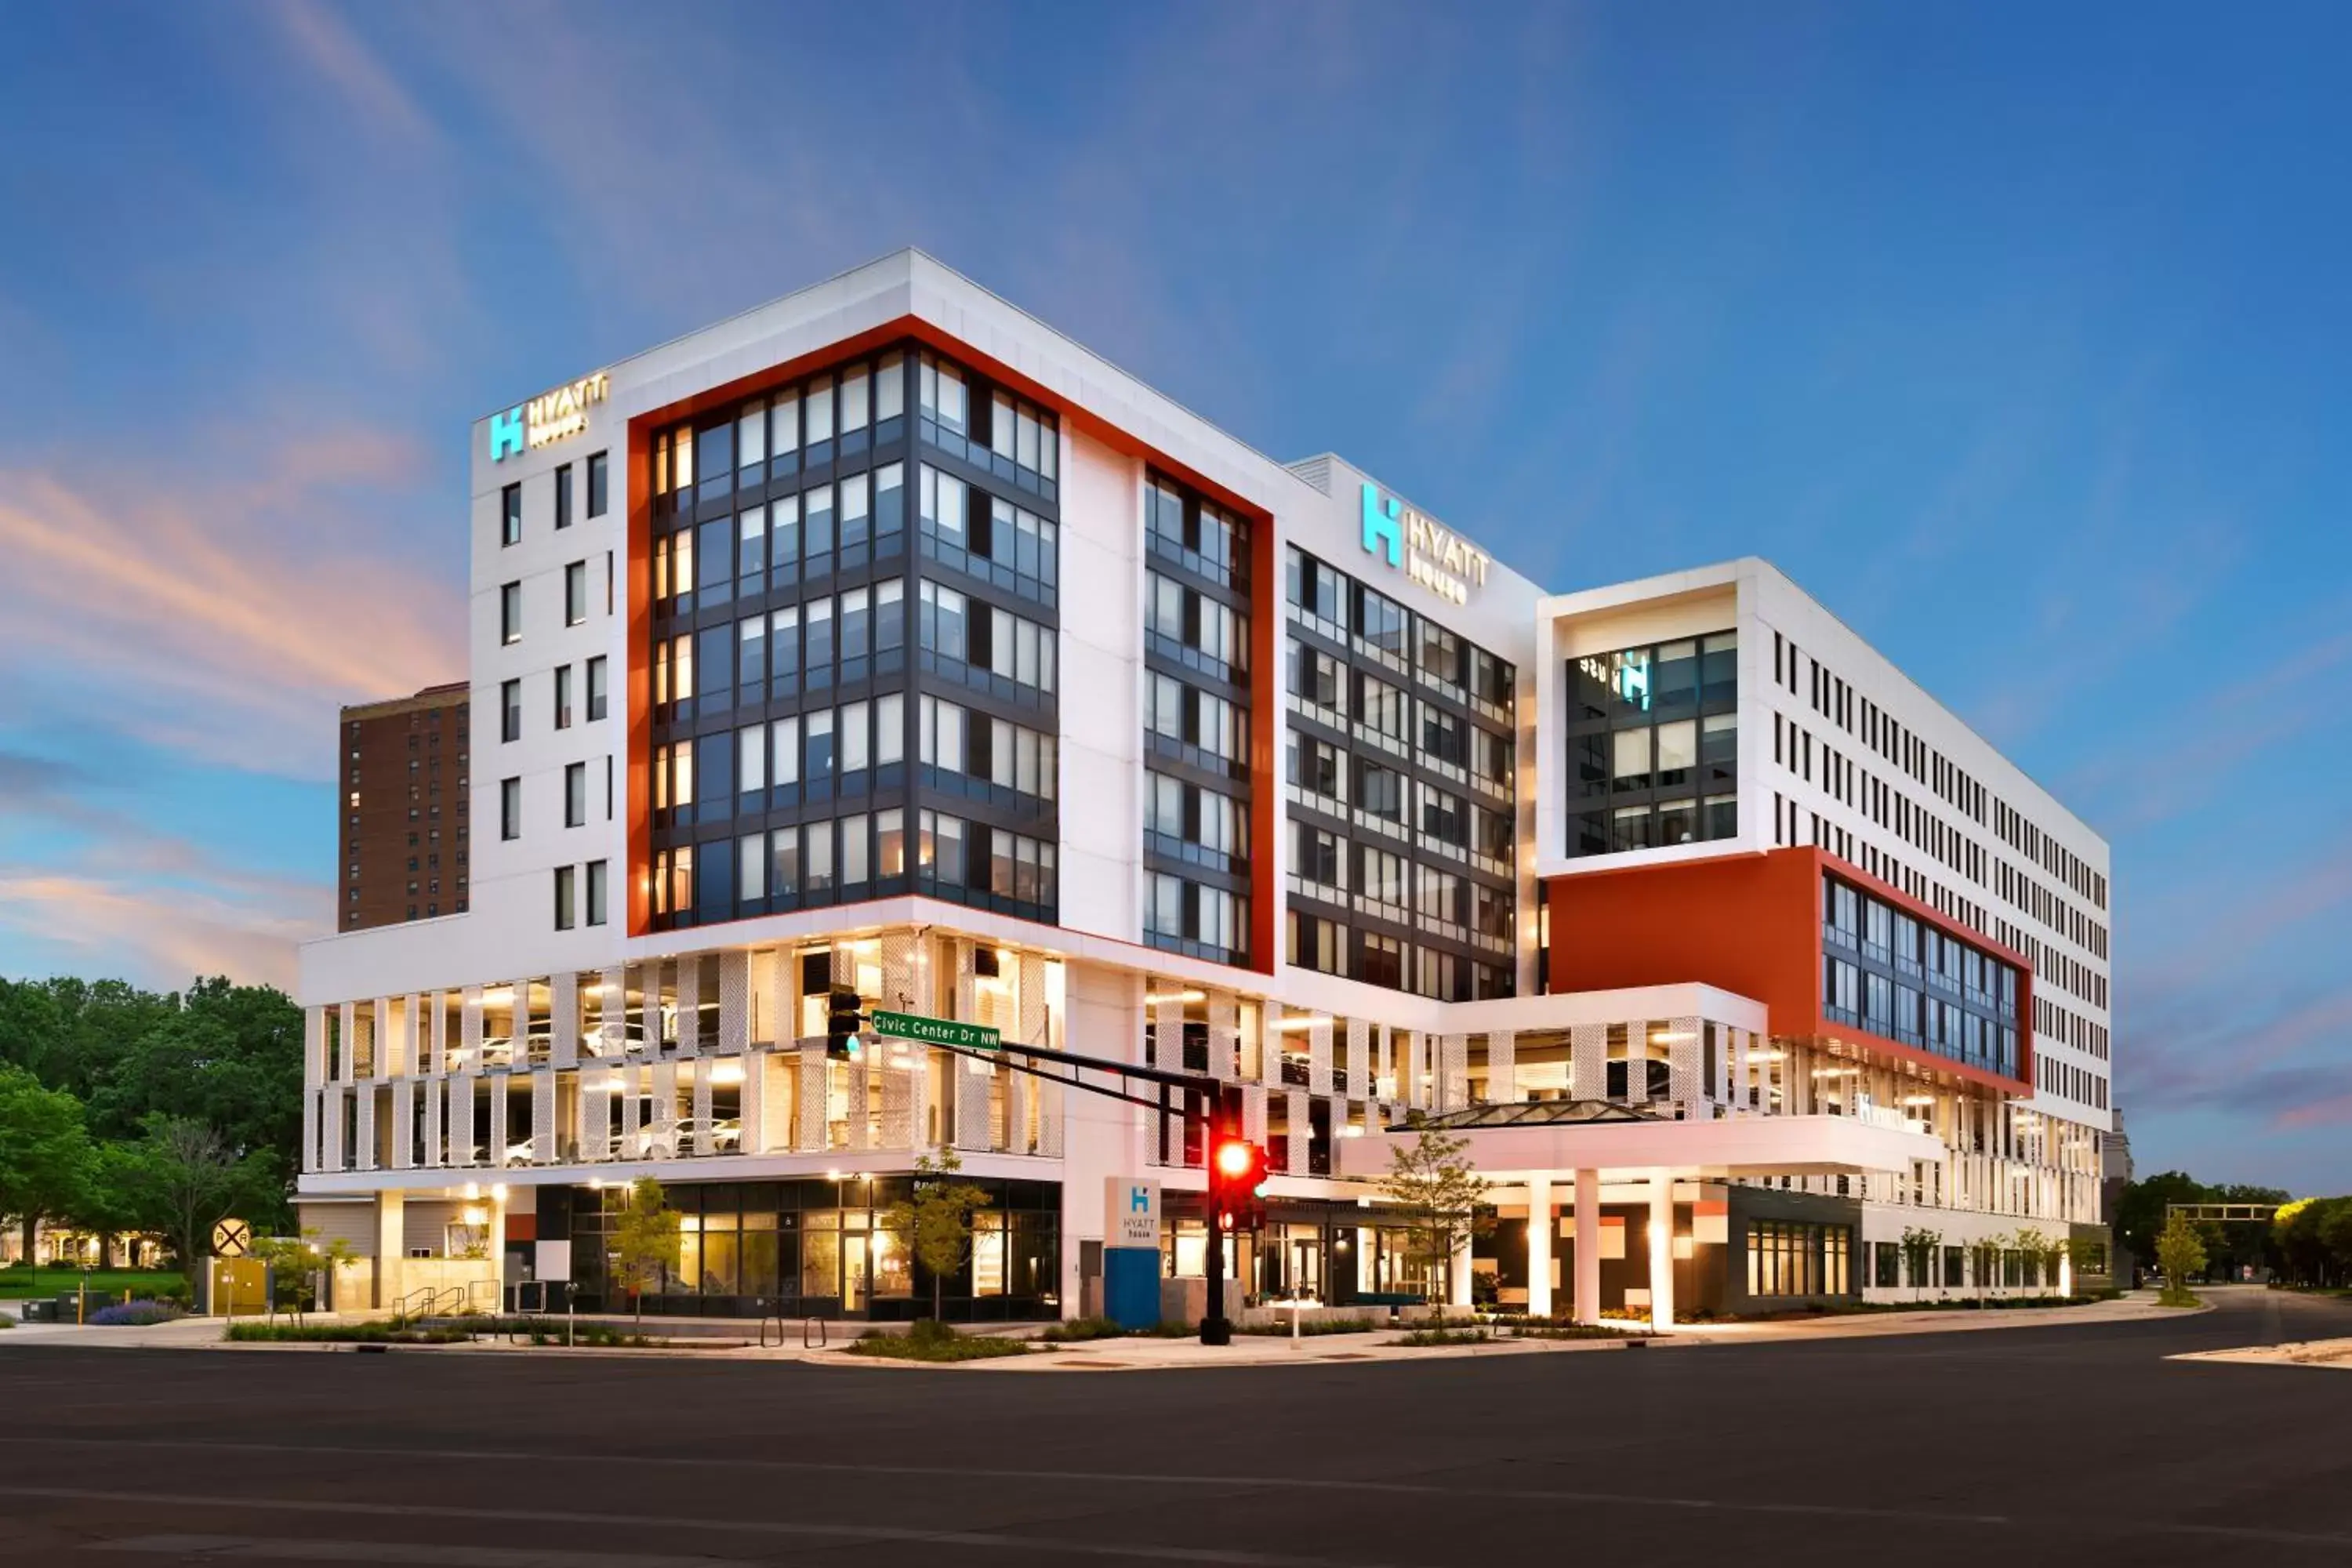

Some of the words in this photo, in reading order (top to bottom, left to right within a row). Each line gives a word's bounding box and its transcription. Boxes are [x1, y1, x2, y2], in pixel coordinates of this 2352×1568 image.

[528, 372, 608, 427] HYATT
[1408, 511, 1490, 588] HYATT
[873, 1015, 906, 1033] Civic
[913, 1022, 955, 1040] Center
[960, 1029, 975, 1042] Dr
[981, 1032, 998, 1046] NW
[1123, 1218, 1154, 1229] HYATT
